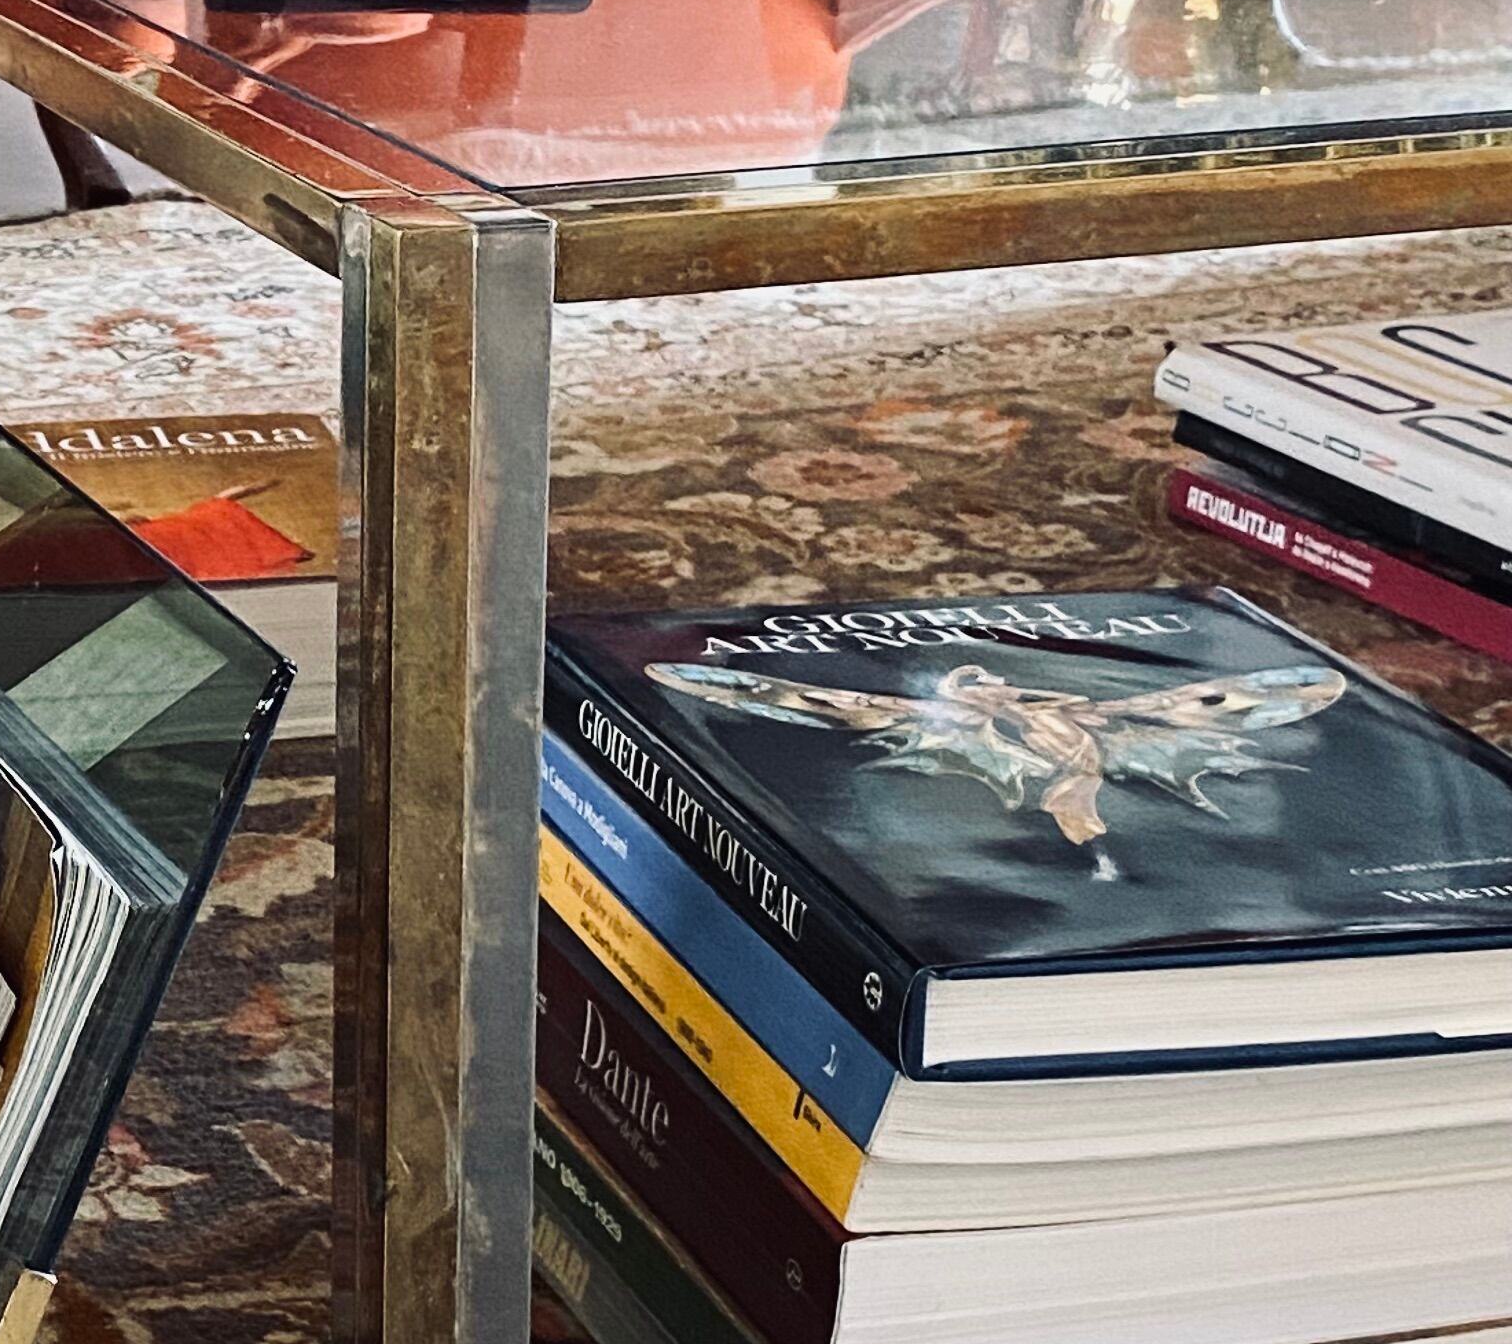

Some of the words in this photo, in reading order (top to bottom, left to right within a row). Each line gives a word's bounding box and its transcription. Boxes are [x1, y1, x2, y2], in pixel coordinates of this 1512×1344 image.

[700, 634, 841, 657] ART
[856, 613, 1192, 651] NOUVEAU
[762, 602, 1078, 635] GIOIELLI
[578, 698, 661, 803] GIOIELLI
[659, 776, 703, 843] ART
[702, 813, 809, 943] NOUVEAU
[1381, 884, 1512, 904] Vivien
[581, 998, 669, 1147] Dante
